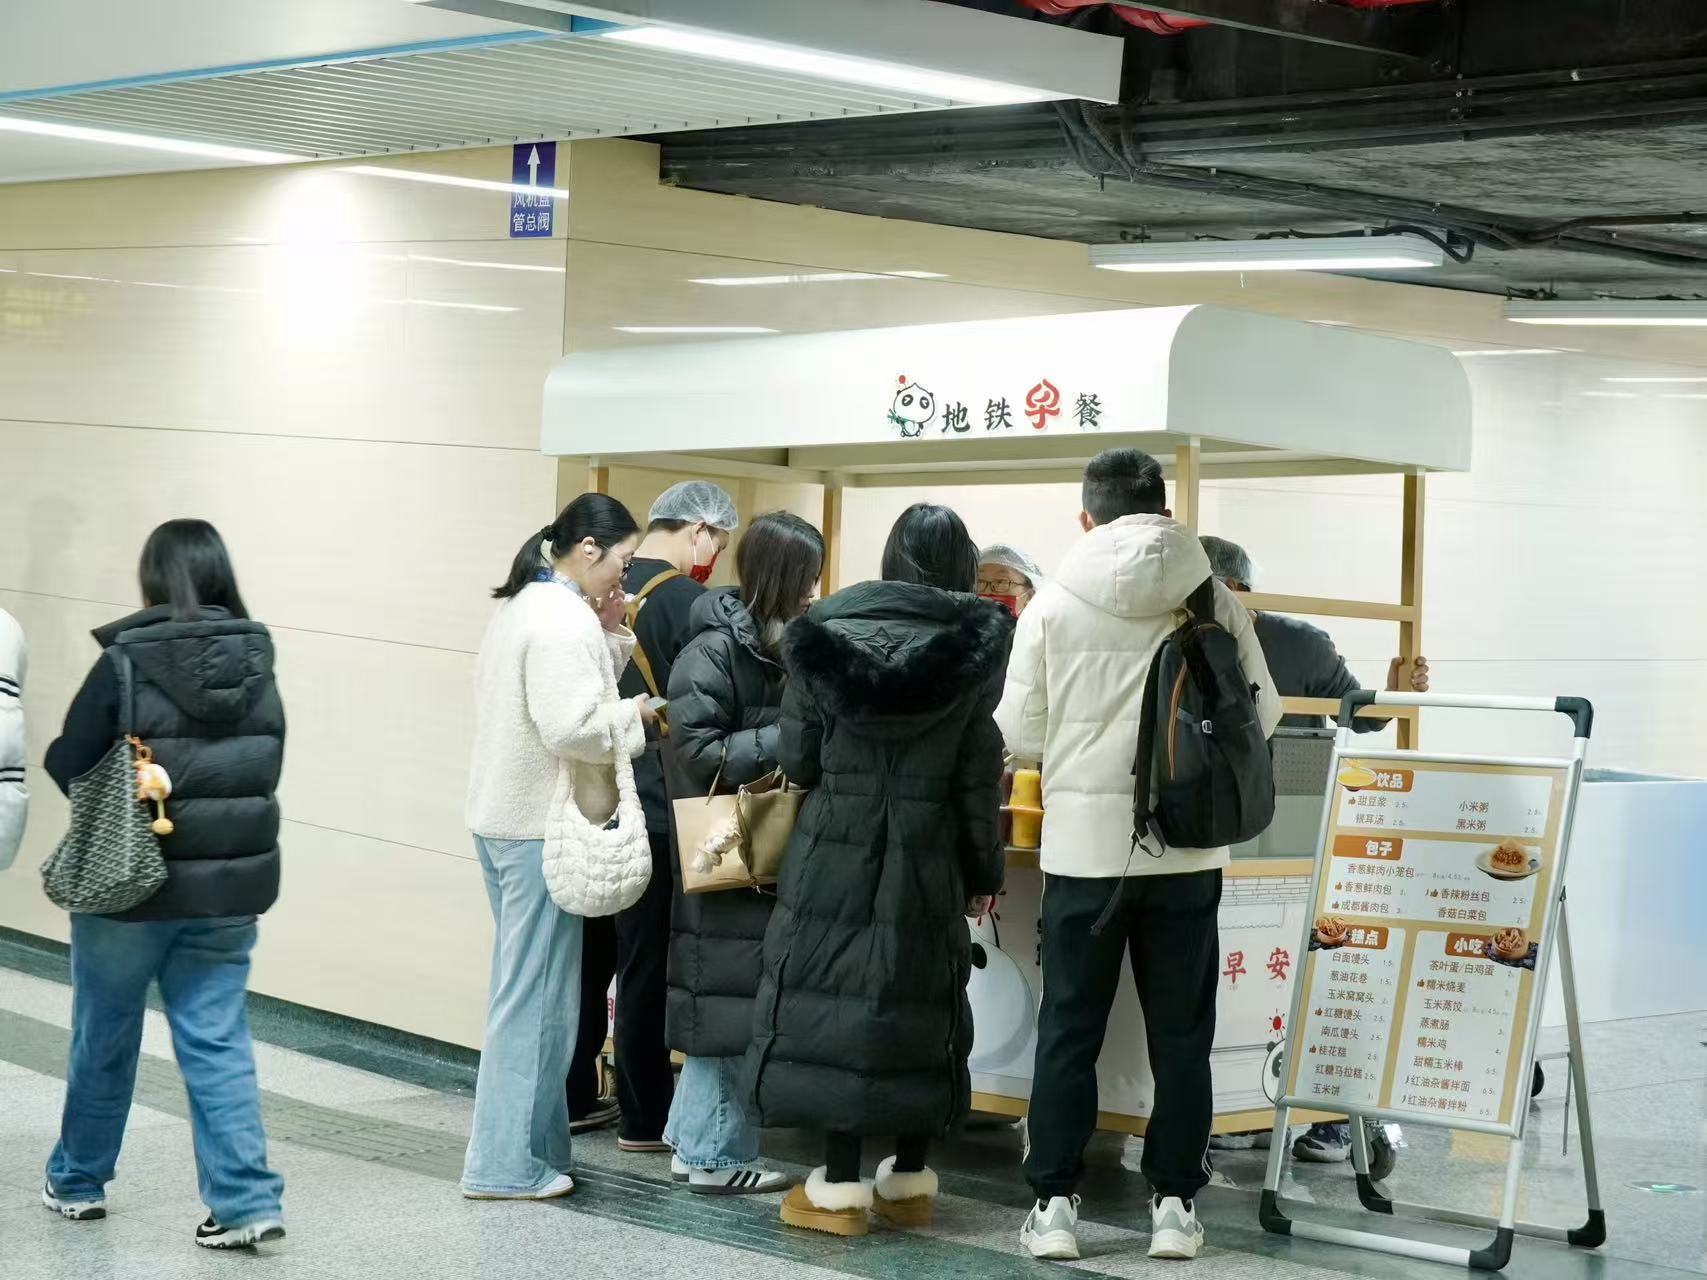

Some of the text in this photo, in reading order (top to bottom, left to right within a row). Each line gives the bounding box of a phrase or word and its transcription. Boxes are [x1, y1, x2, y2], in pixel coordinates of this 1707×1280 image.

[513, 212, 550, 232] 管总阀
[942, 378, 1102, 432] 地铁早餐
[1376, 773, 1403, 788] 饮品
[1357, 795, 1387, 807] 甜豆浆
[1459, 800, 1489, 813] 小米粥
[1455, 818, 1487, 831] 黑米粥
[1365, 840, 1393, 857] 包子
[1347, 863, 1415, 878] 香葱鲜肉小笼包
[1345, 882, 1392, 895] 香葱鲜肉包
[1441, 888, 1490, 902] 香辣粉丝包
[1341, 901, 1389, 914] 成都酱肉包
[1438, 906, 1487, 921] 香菇白菜包
[1350, 928, 1379, 946] 糕点
[1454, 937, 1484, 955] 小吃
[1222, 947, 1291, 984] 早安
[1332, 952, 1370, 965] 白面馒头
[1429, 960, 1495, 976] 茶叶蛋/白鸡蛋
[1330, 970, 1368, 984] 葱油花卷
[1426, 979, 1466, 993] 糯米烧麦
[1328, 989, 1374, 1004] 玉米窝窝头
[1424, 998, 1463, 1013] 玉米蒸饺
[1324, 1007, 1361, 1021] 红糖馒头
[1321, 1026, 1359, 1040] 南瓜馒头
[1319, 1044, 1347, 1057] 桂花糕
[1416, 1036, 1447, 1051] 糯米鸡
[1315, 1063, 1363, 1079] 红糖马拉糕
[1413, 1055, 1464, 1072] 甜糯玉米棒
[1312, 1082, 1340, 1097] 玉米饼
[1411, 1075, 1471, 1093] 红油杂酱拌面
[1407, 1094, 1467, 1112] 红油杂酱拌粉
